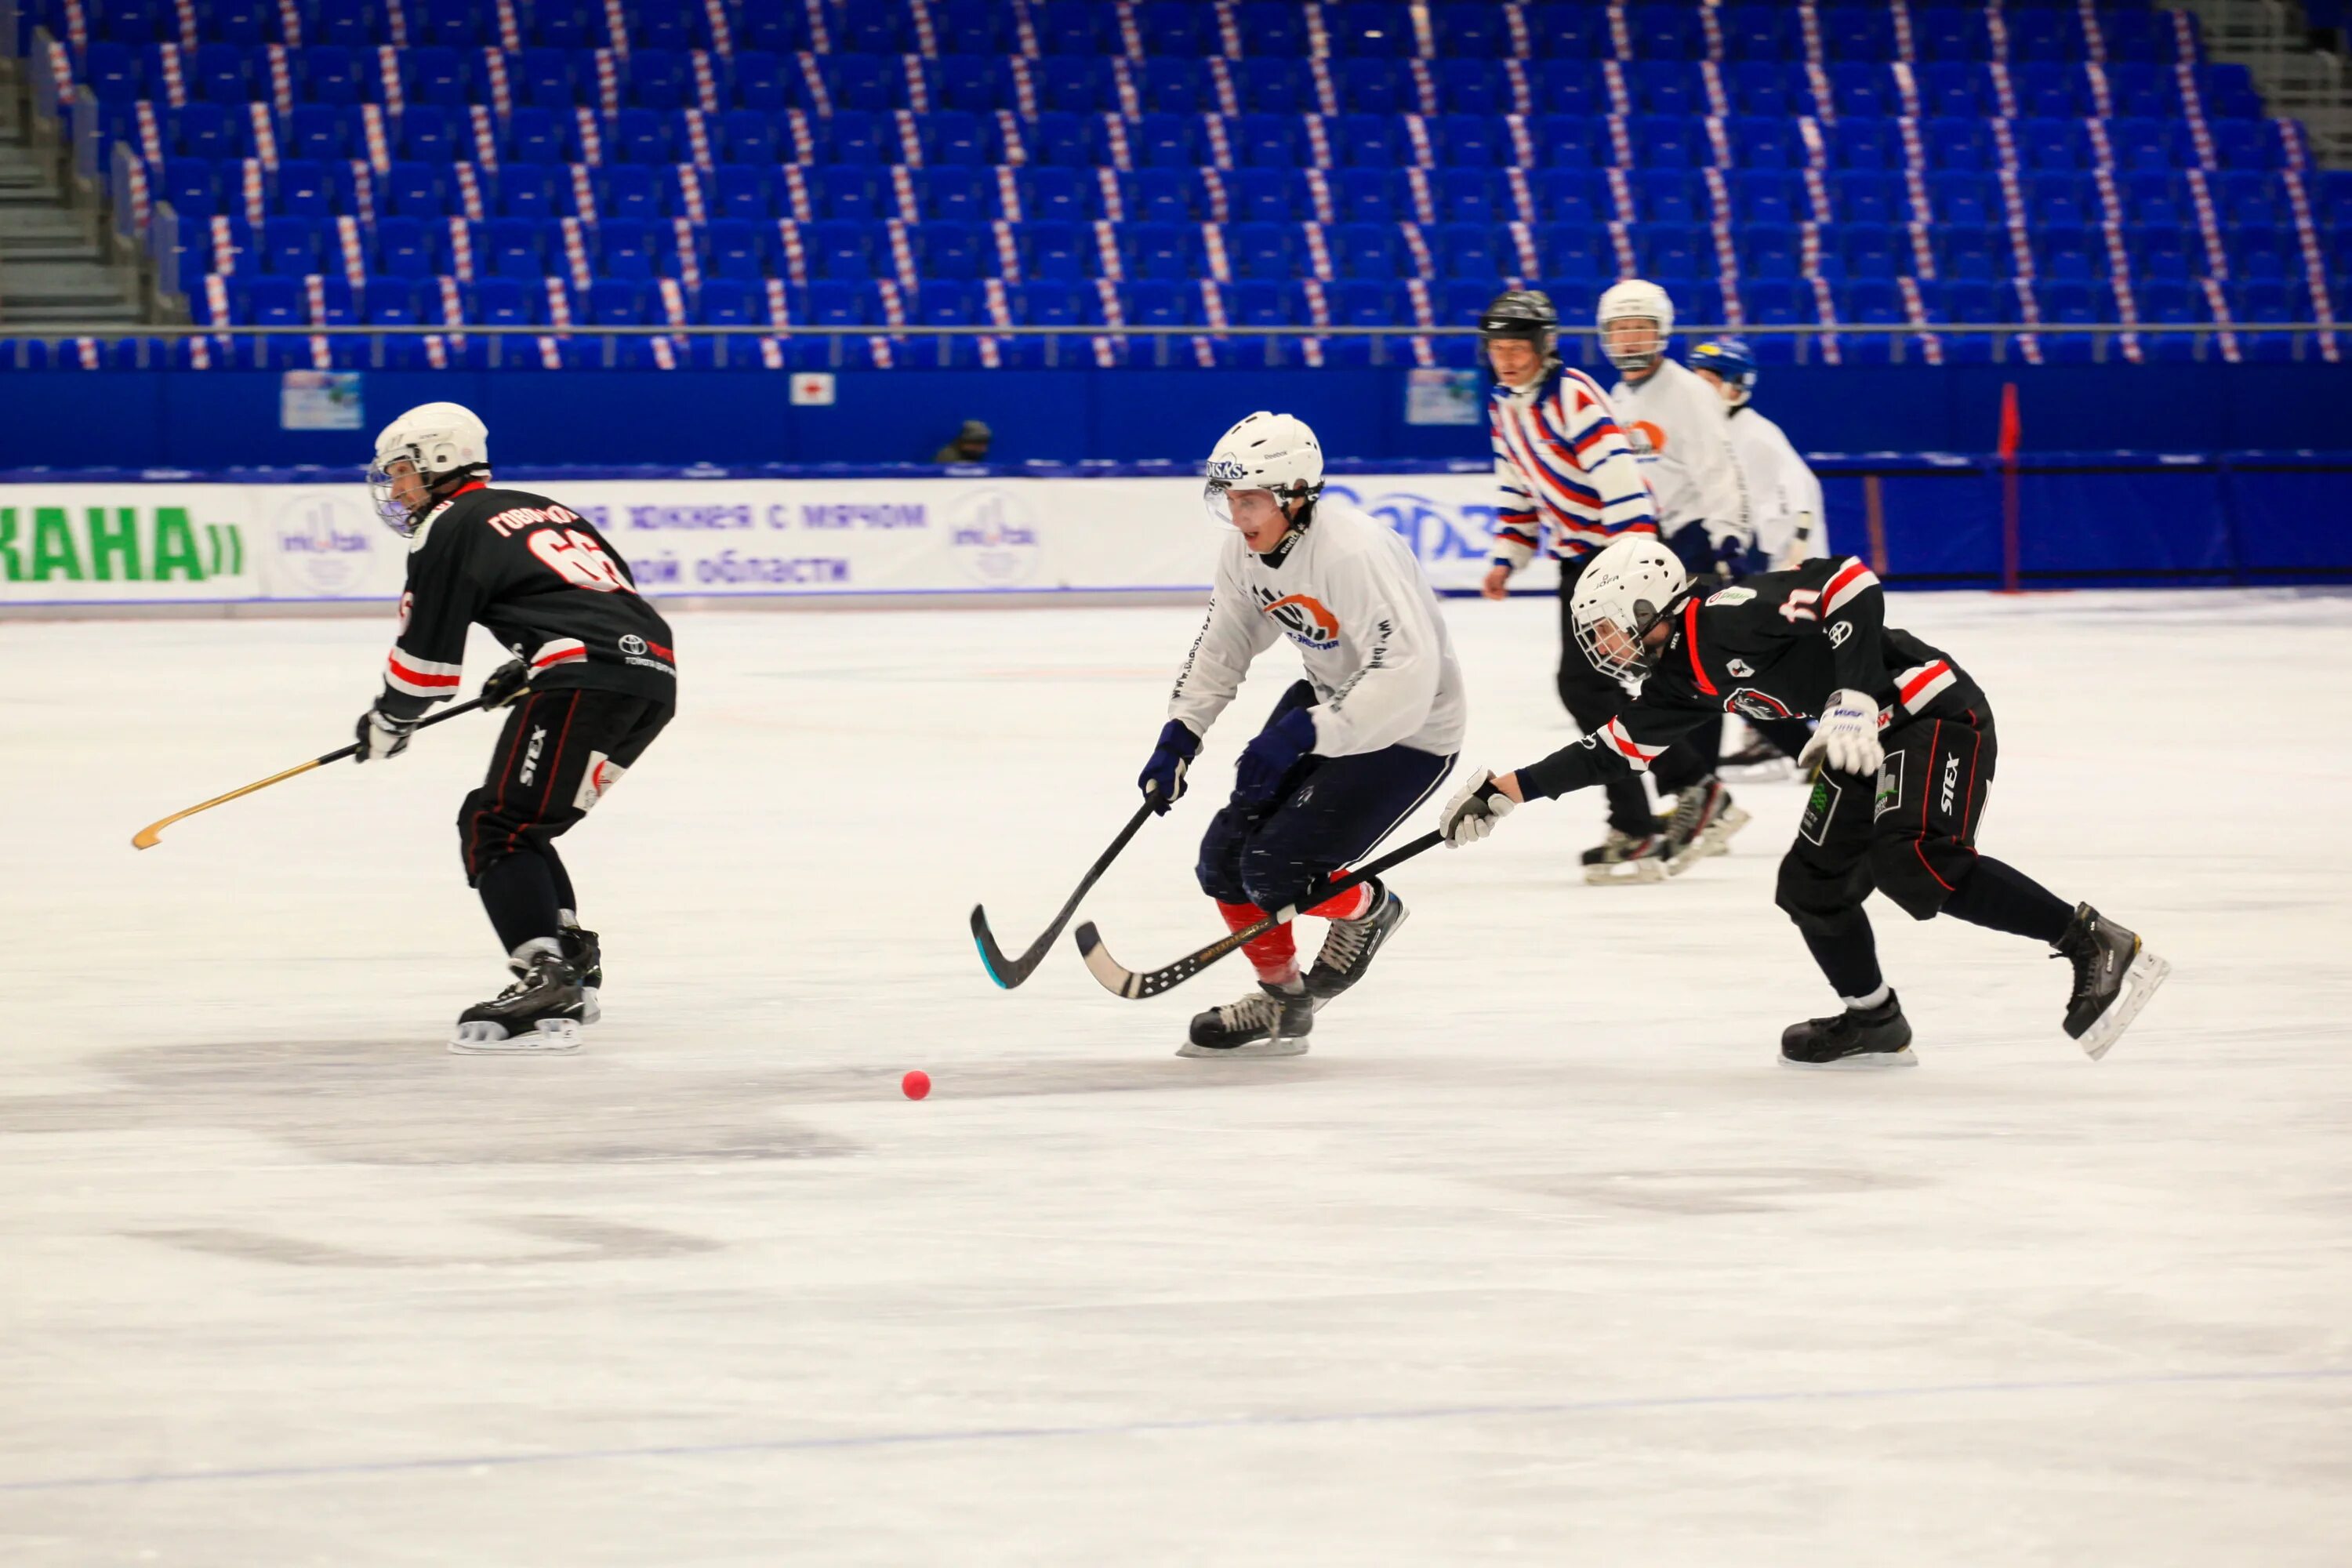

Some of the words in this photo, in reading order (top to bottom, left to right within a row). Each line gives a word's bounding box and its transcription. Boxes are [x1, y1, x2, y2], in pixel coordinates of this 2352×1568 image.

[527, 528, 637, 593] 66
[519, 724, 548, 787] STEX
[1940, 751, 1960, 816] STEX
